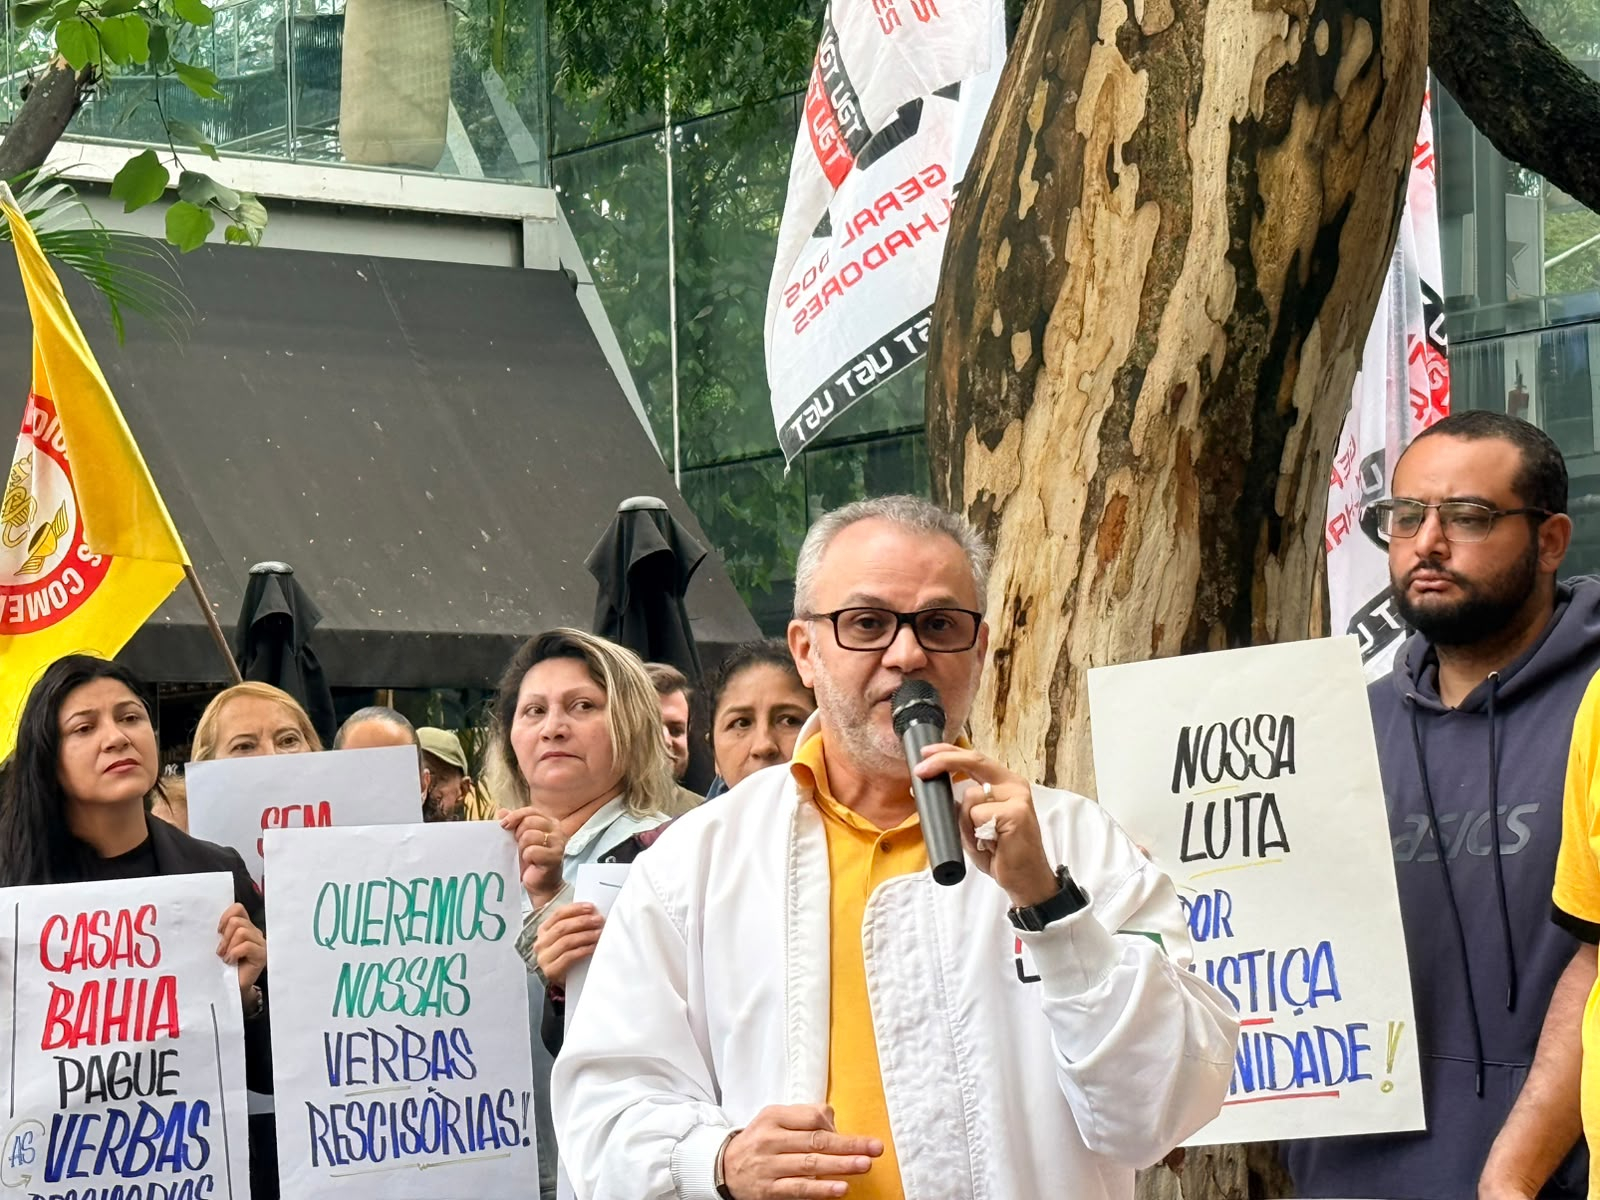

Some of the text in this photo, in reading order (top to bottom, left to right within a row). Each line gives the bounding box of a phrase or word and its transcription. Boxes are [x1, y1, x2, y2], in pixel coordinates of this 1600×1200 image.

[812, 108, 850, 167] UGT
[831, 80, 863, 140] UGT
[0, 567, 85, 624] COME
[1171, 713, 1297, 794] NOSSA
[1180, 792, 1290, 863] LUTA
[39, 904, 162, 974] CASAS
[312, 871, 507, 951] QUEREMOS
[41, 975, 180, 1051] BAHIA
[332, 952, 471, 1019] NOSSAS
[53, 1048, 181, 1110] PAGUE
[323, 1024, 478, 1087] VERBAS
[1229, 1022, 1373, 1096] NIDADE
[8, 1130, 36, 1168] AS
[44, 1099, 211, 1183] VERBAS
